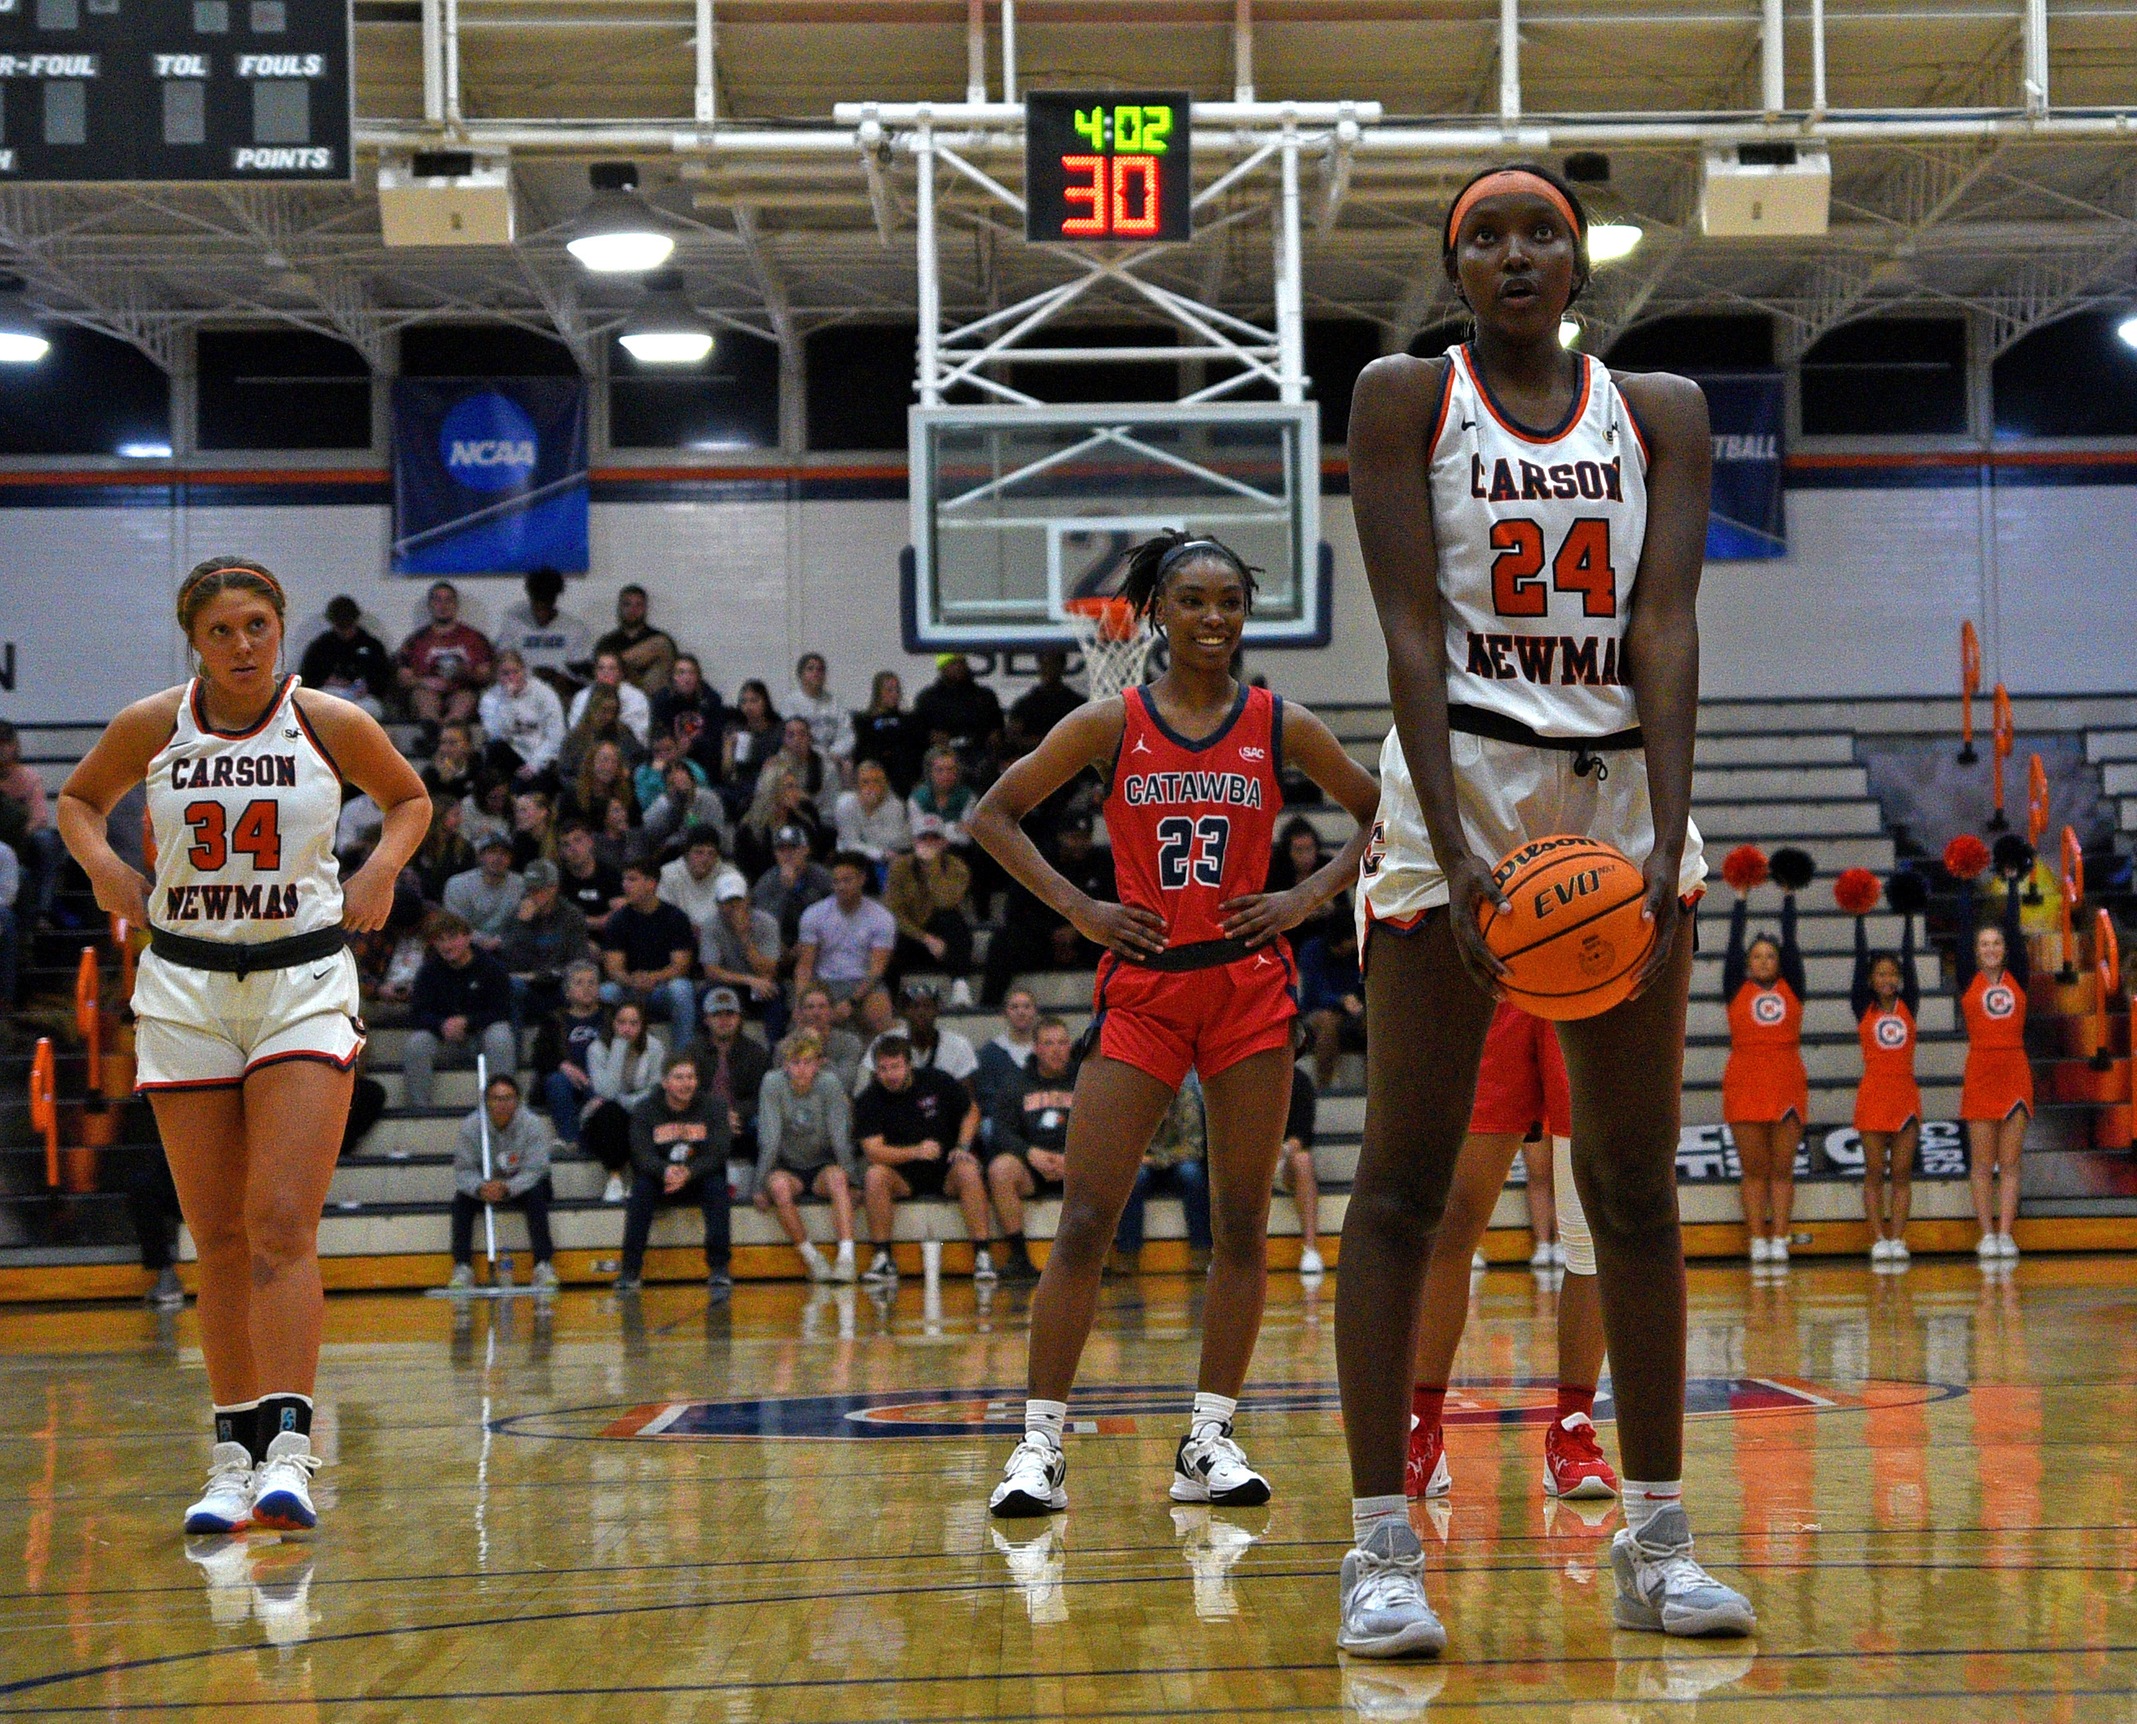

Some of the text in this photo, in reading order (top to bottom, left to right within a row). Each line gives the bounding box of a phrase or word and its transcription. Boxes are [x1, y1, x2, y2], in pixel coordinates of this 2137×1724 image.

[156, 55, 207, 77] TOL
[239, 55, 322, 77] FOULS
[1074, 106, 1172, 154] 4:02
[235, 148, 331, 170] POINTS
[1061, 155, 1159, 235] 30
[449, 440, 536, 467] NCAA
[1711, 434, 1779, 459] TBALL
[1471, 453, 1624, 503] CARSON
[1490, 517, 1616, 618] 24
[1466, 631, 1632, 687] NEWMA
[171, 755, 297, 790] CARSON
[1243, 747, 1265, 760] SAC
[1124, 771, 1262, 810] CATAWBA
[184, 799, 281, 872] 34
[1156, 814, 1231, 890] 23
[167, 883, 299, 921] NEWMAN
